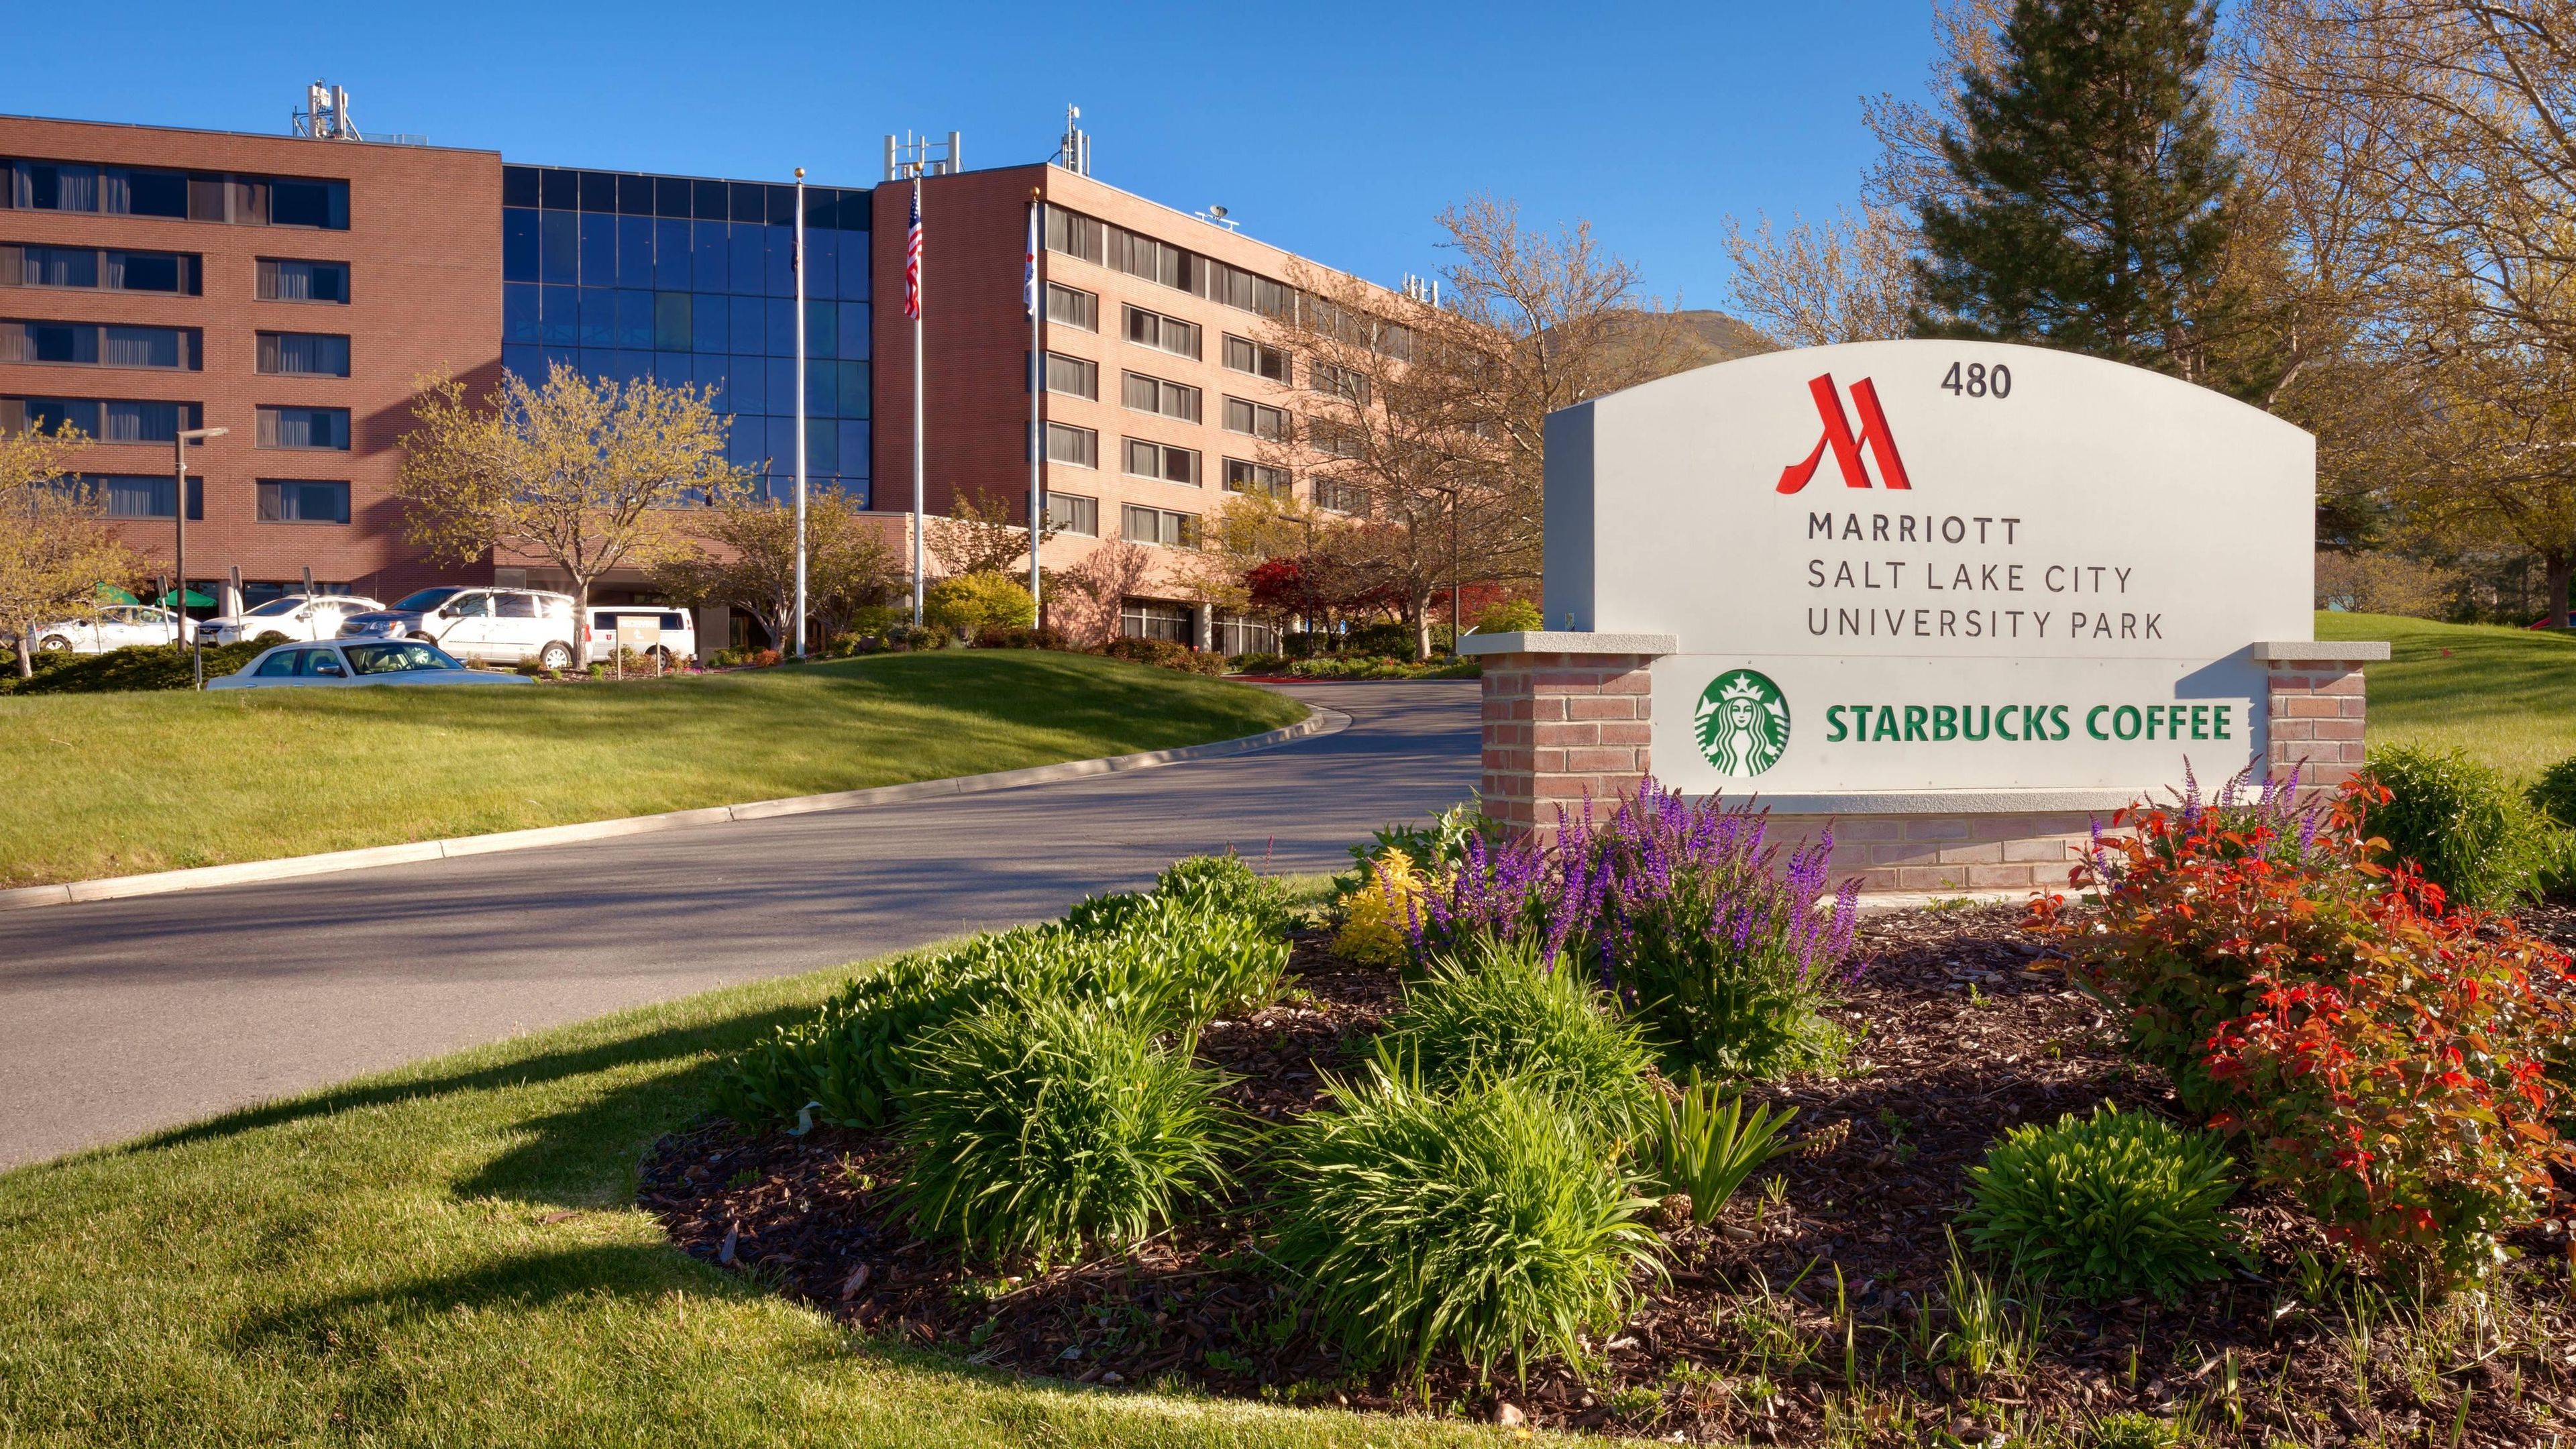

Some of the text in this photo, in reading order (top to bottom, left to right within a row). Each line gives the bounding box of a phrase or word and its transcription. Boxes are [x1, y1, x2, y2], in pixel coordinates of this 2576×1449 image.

[1941, 362, 2011, 399] 480
[1809, 512, 2021, 545] MARRIOTT
[1808, 559, 2132, 594] SALT LAKE CITY
[1809, 607, 2162, 639] UNIVERSITY PARK
[1827, 705, 2231, 741] STARBUCKS COFFEE
